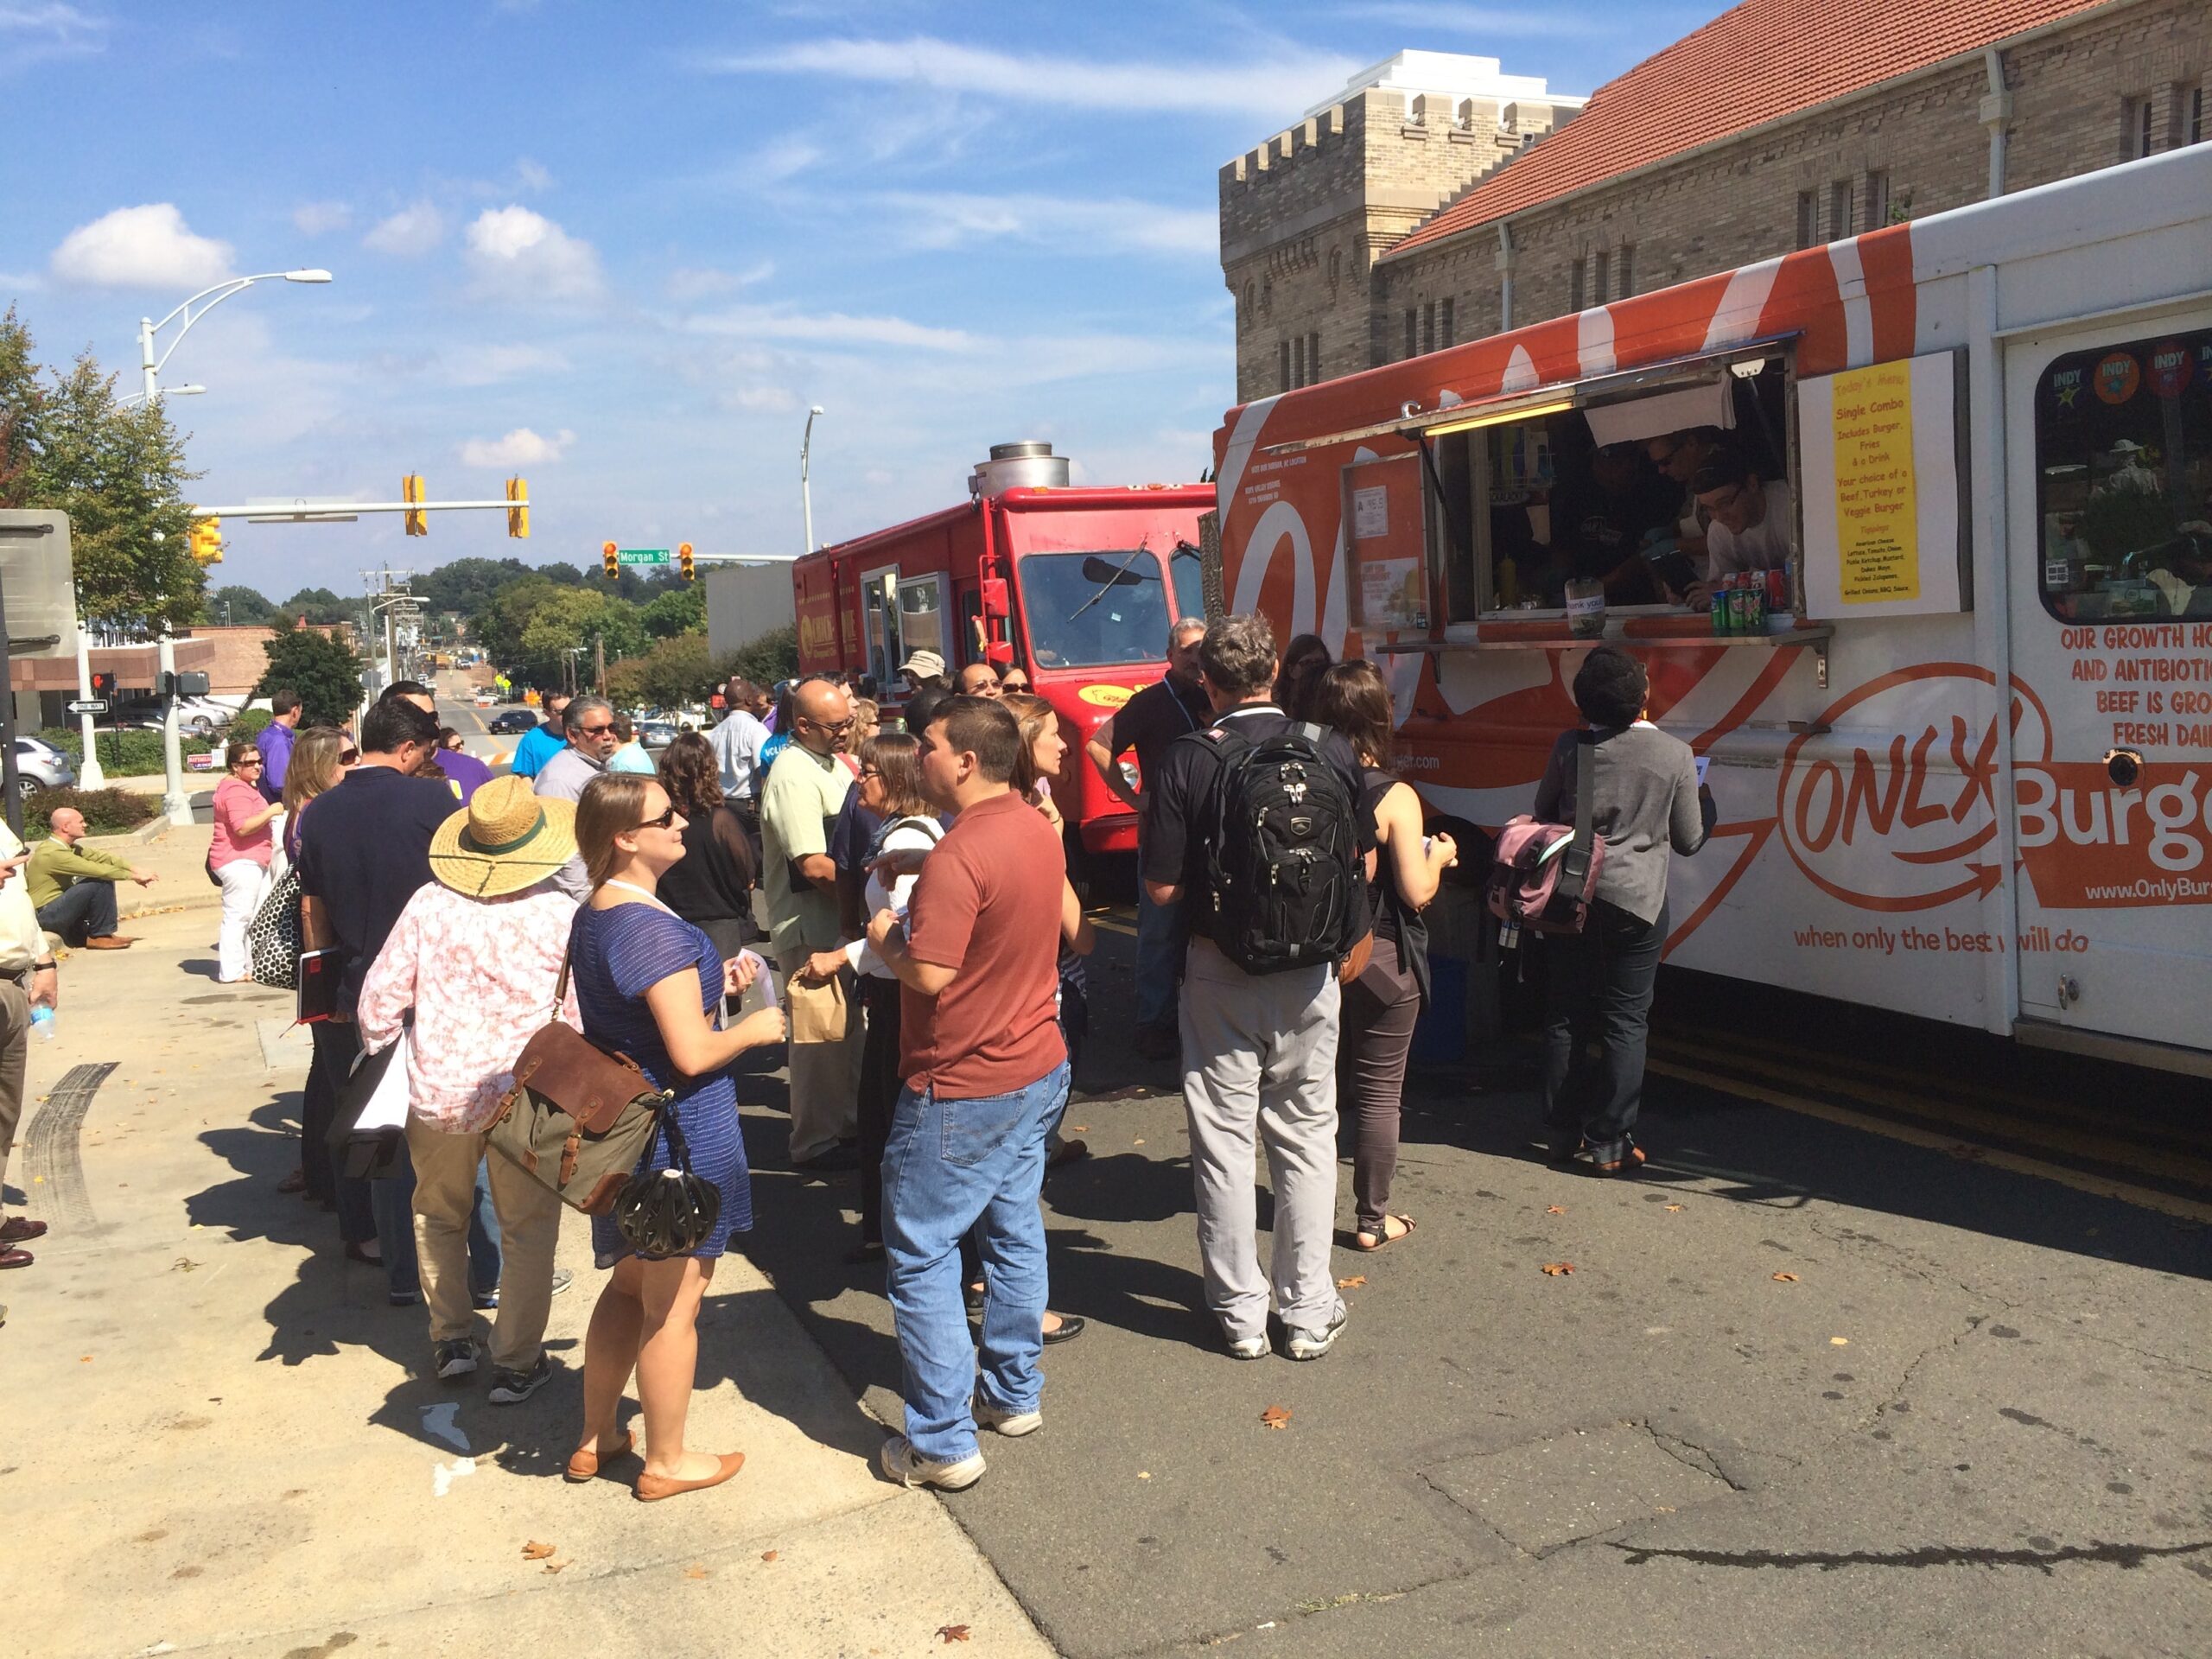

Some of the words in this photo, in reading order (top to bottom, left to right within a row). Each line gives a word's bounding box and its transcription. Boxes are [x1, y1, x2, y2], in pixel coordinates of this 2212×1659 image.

[2102, 359, 2130, 378] INDY
[2154, 351, 2184, 370] INDY
[2054, 369, 2082, 388] INDY
[1836, 404, 1866, 421] Single
[1870, 398, 1904, 413] Combo
[1838, 428, 1870, 441] Includes
[1859, 441, 1880, 450] Fries
[1853, 458, 1858, 467] &
[1869, 452, 1890, 464] Drink
[1837, 478, 1856, 487] Your
[1859, 474, 1885, 484] choice
[1889, 468, 1898, 480] of
[1863, 487, 1893, 499] Turkey
[1844, 505, 1871, 518] Veggie
[1875, 503, 1904, 514] Burger
[620, 551, 654, 563] Morgan
[658, 552, 669, 562] St
[2061, 627, 2096, 650] OUR
[2103, 626, 2184, 650] GROWTH
[2072, 659, 2107, 681] AND
[2114, 658, 2212, 682] ANTIBIOTI
[2096, 690, 2139, 714] BEEF
[2147, 691, 2164, 714] IS
[2171, 691, 2212, 715] GRO
[2113, 722, 2169, 747] FRESH
[1796, 696, 2024, 853] ONLY
[1994, 766, 2212, 871] Burg
[2085, 877, 2212, 901] www.OnlyBur
[1794, 925, 1847, 949] when
[1853, 926, 1896, 955] only
[1901, 926, 1941, 950] the
[1944, 927, 1992, 952] best
[2054, 929, 2090, 953] do
